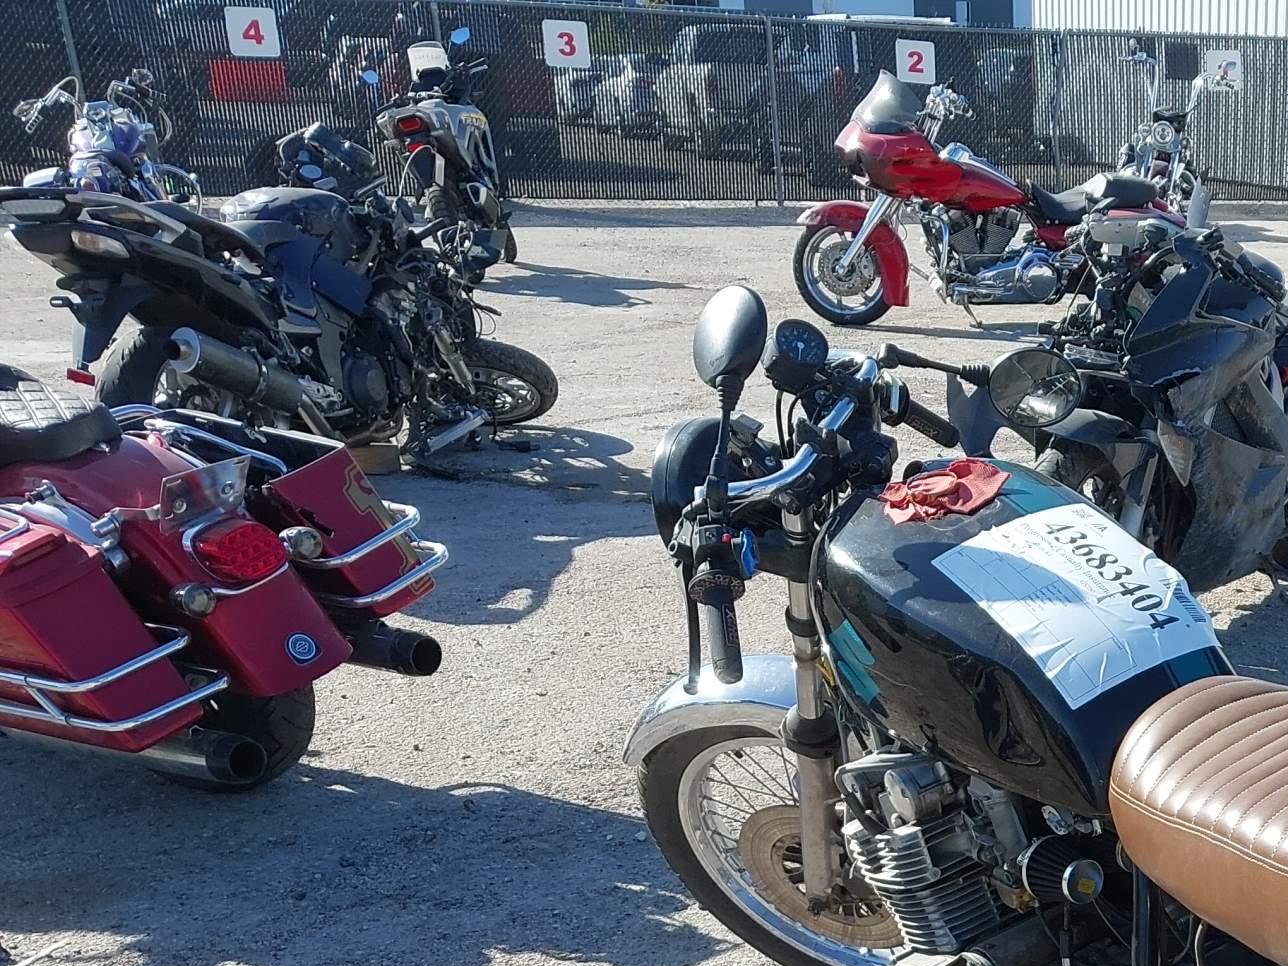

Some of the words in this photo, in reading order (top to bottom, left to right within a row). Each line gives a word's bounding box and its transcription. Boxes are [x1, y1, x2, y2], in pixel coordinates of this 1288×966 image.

[242, 19, 264, 45] 4
[557, 31, 577, 57] 3
[907, 50, 924, 73] 2
[1045, 522, 1180, 630] 43683404
